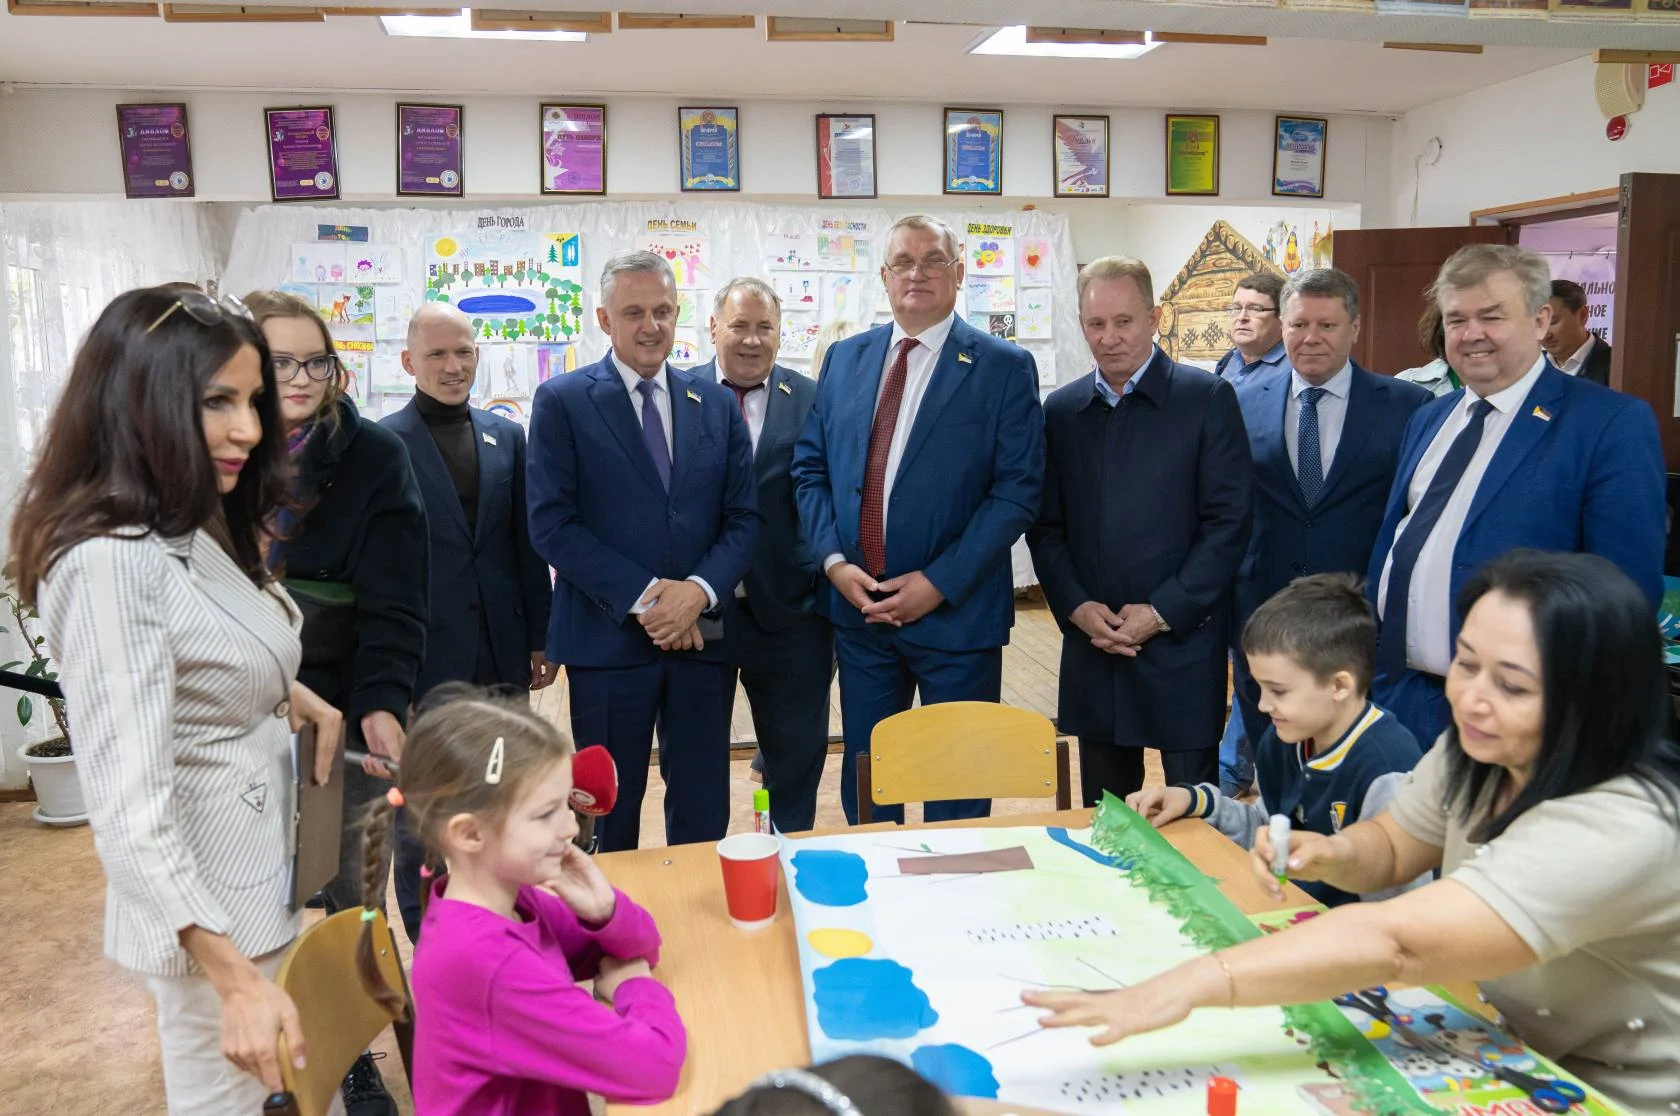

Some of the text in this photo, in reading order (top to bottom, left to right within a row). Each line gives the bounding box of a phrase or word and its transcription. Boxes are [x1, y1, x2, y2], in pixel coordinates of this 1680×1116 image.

[477, 216, 525, 229] ДЕНЬ ГОРОДА
[647, 219, 697, 232] ДЕНЬ СЕМЬИ
[967, 223, 1013, 236] ДЕНЬ ЗДОРОВЬЯ
[1576, 281, 1616, 296] АЛЬНО
